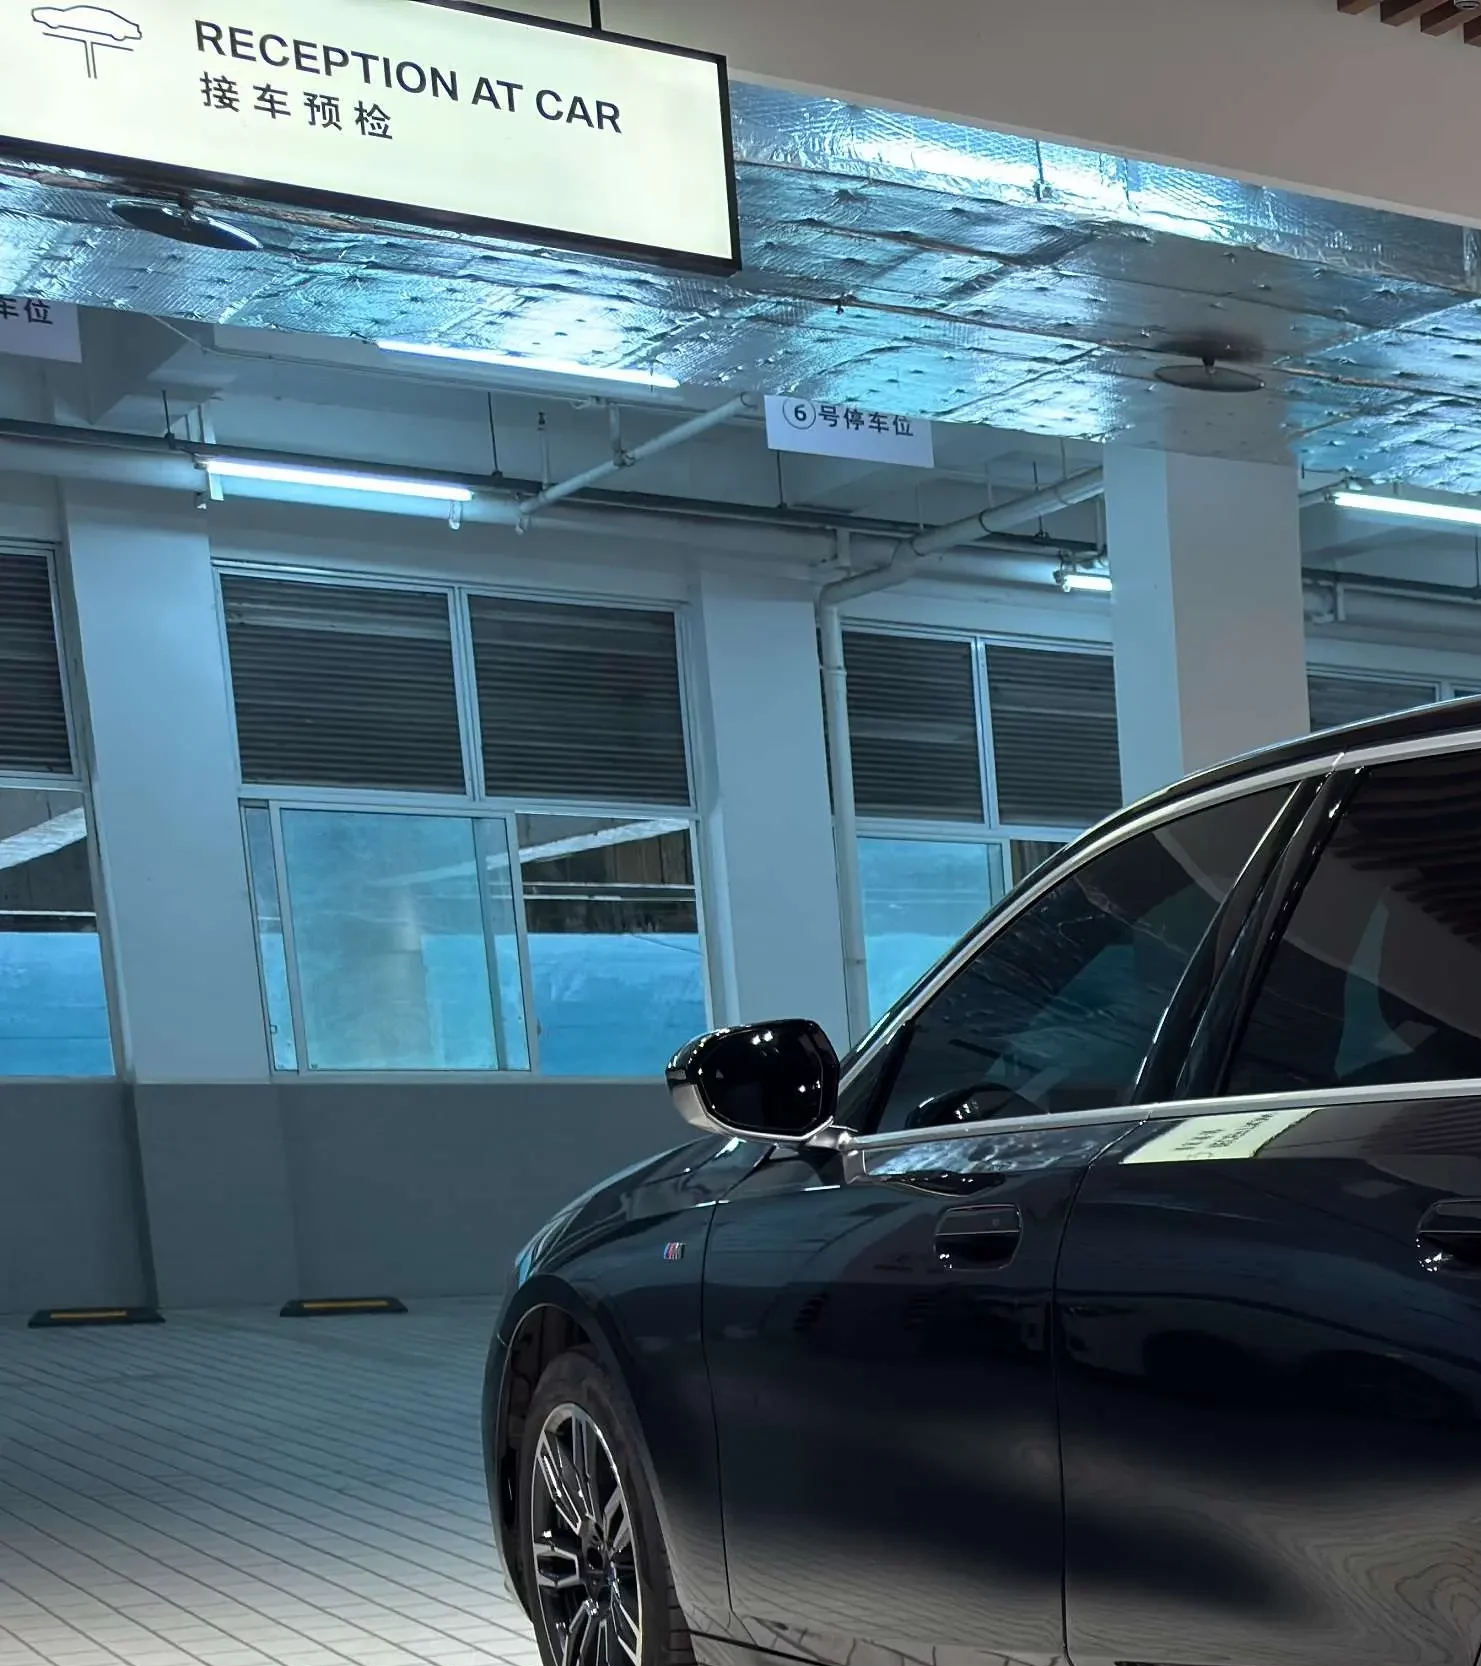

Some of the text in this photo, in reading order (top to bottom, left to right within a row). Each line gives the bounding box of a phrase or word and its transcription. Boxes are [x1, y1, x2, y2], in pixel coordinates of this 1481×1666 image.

[195, 19, 623, 135] RECEPTION AT CAR
[199, 71, 393, 140] 接车预检
